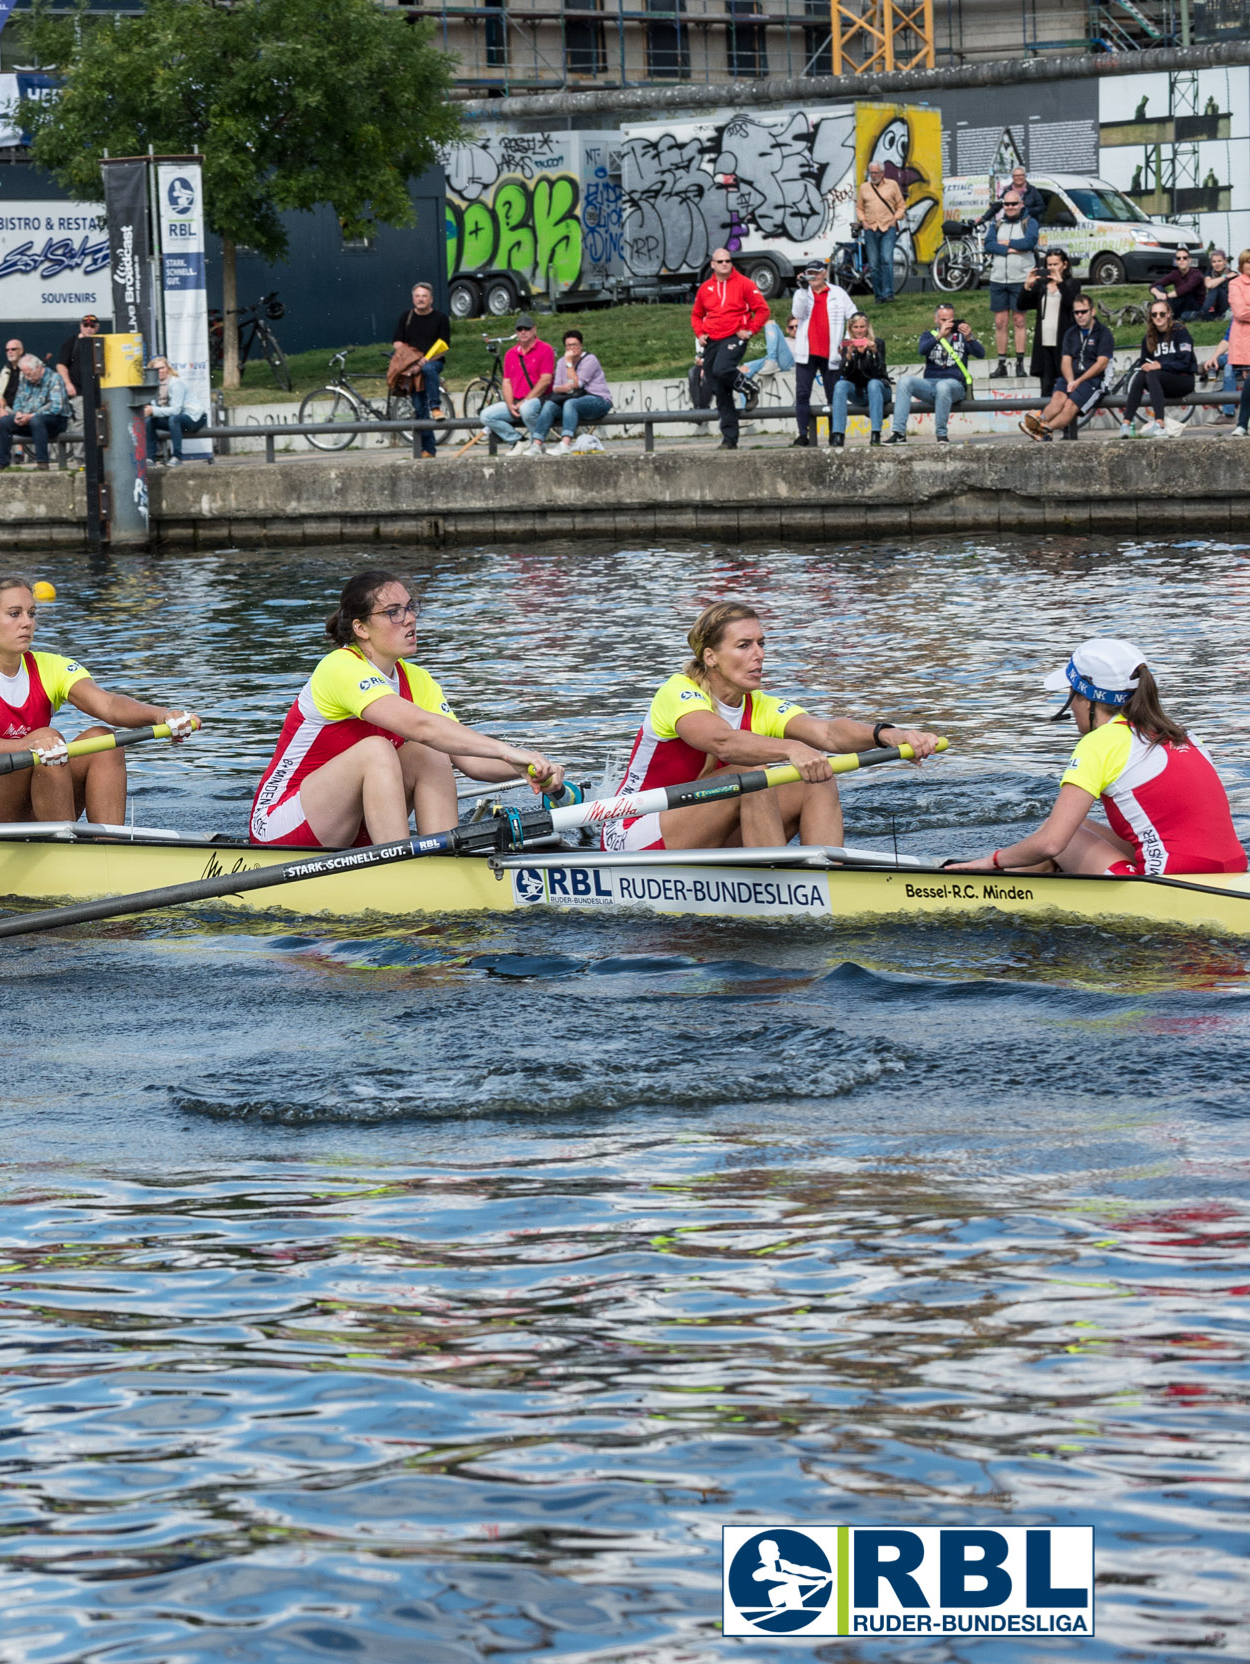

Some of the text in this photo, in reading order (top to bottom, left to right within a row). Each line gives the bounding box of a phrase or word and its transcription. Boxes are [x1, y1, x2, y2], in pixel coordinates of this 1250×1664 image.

[45, 217, 55, 231] &
[169, 223, 197, 237] RBL
[120, 225, 135, 303] Broadcast
[165, 259, 187, 268] STARK.
[165, 267, 197, 277] SCHNELL.
[166, 277, 181, 285] GUT.
[41, 292, 97, 304] SOUVENIRS
[1078, 680, 1089, 693] NK
[1092, 689, 1107, 700] NK
[1114, 694, 1128, 703] NK
[582, 797, 640, 825] Melitta
[288, 838, 440, 878] STARK. SCHNELL. GUT. RBL
[547, 868, 613, 897] RBL
[619, 876, 825, 907] RUDER-BUNDESLIGA
[905, 884, 1034, 900] Bessel-R.C. Minden
[550, 896, 614, 905] RUDER-BUNDESLIGA
